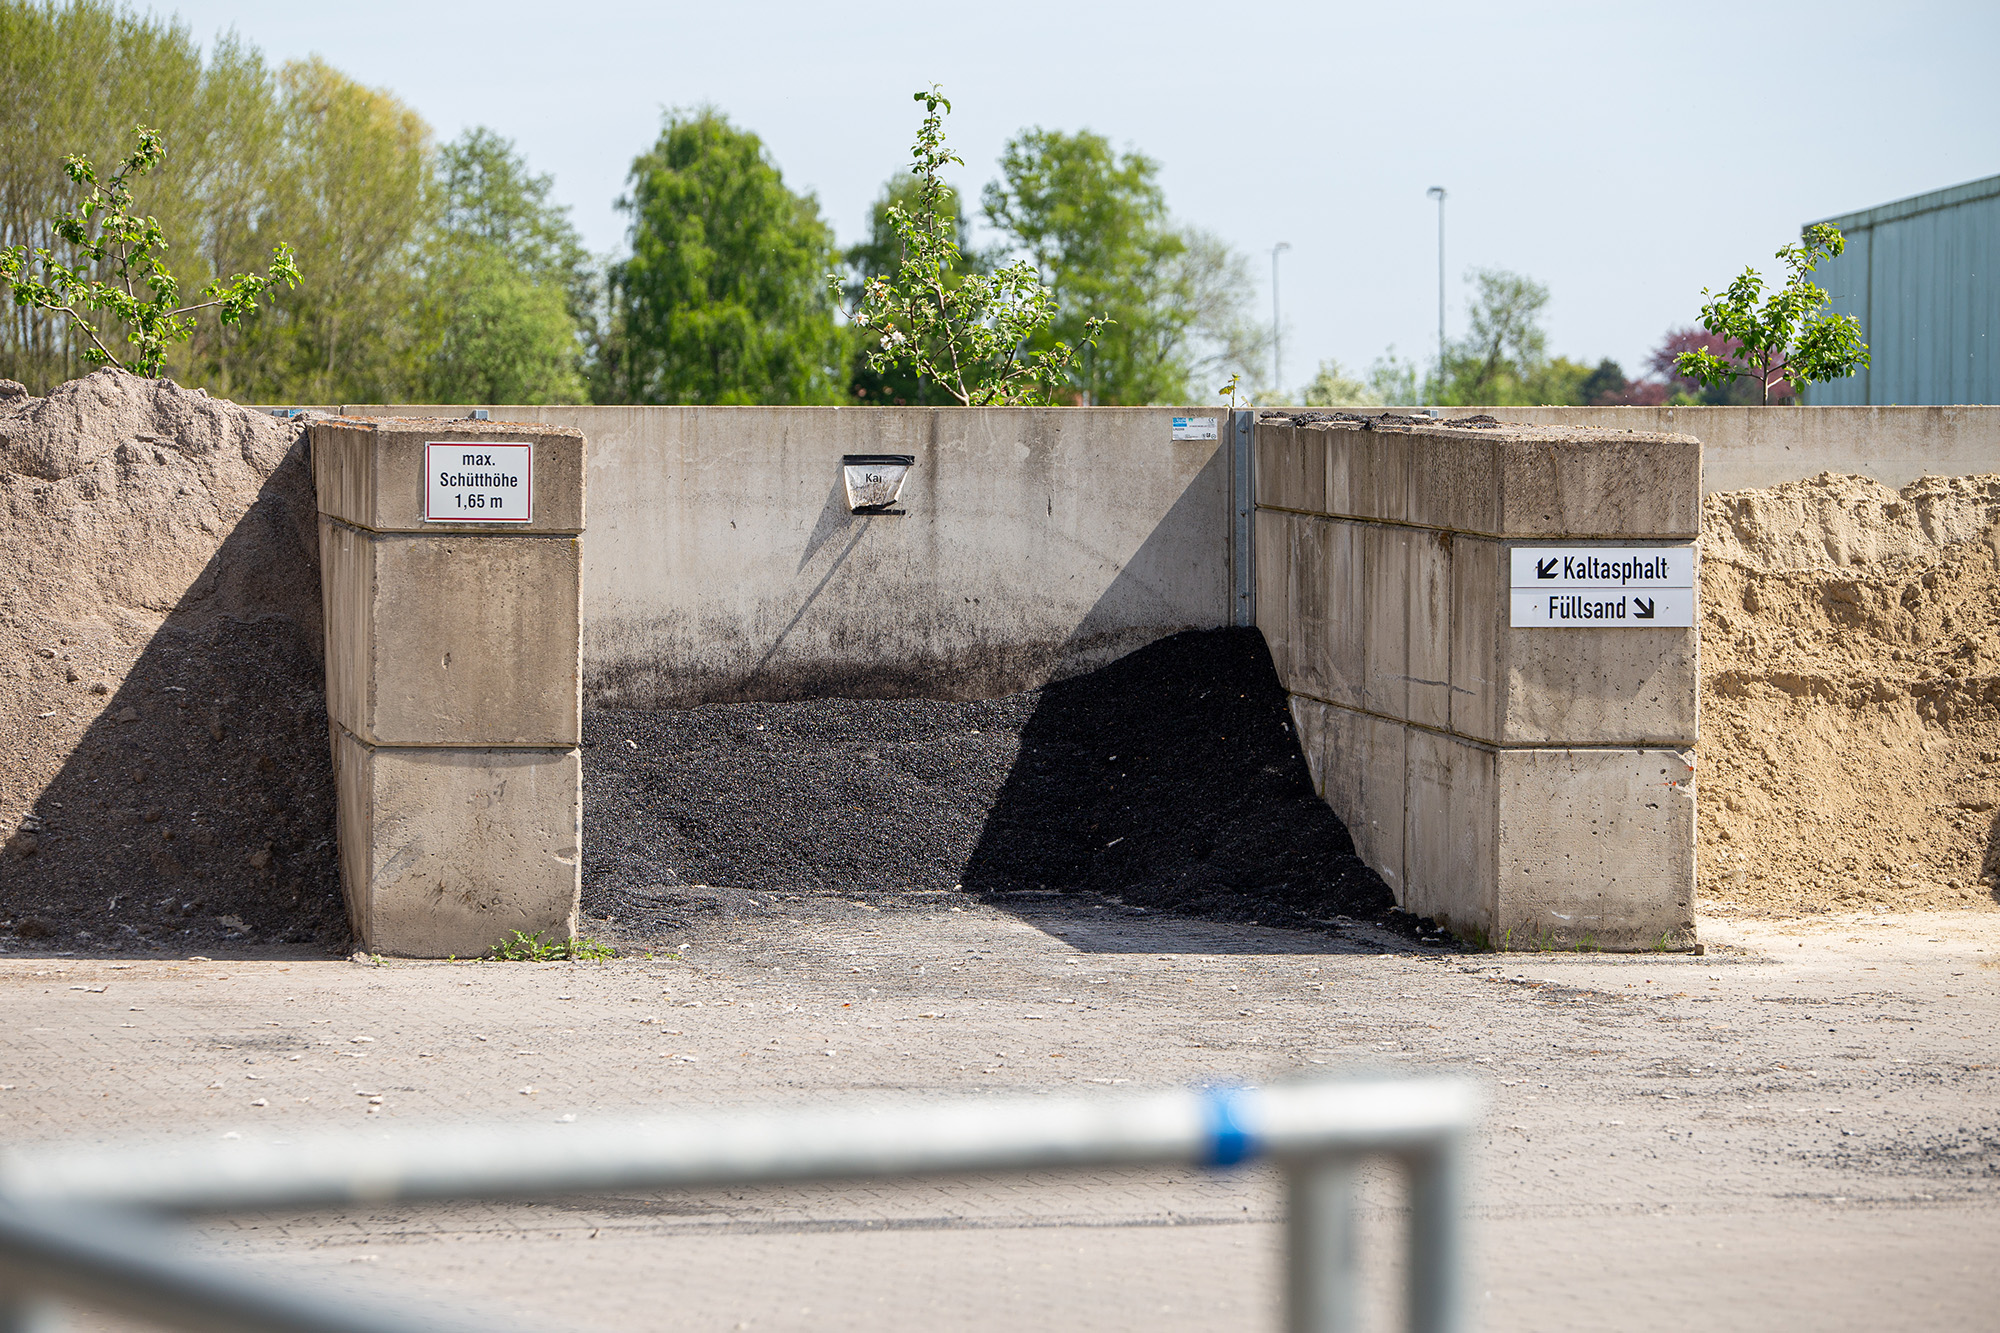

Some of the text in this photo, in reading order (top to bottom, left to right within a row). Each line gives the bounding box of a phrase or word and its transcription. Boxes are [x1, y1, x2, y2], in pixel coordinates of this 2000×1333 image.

[462, 454, 496, 465] max.
[439, 472, 518, 487] Schütthöhe
[454, 494, 503, 510] 1,65 m
[1563, 556, 1668, 585] Kaltasphalt
[1549, 595, 1626, 619] Füllsand
